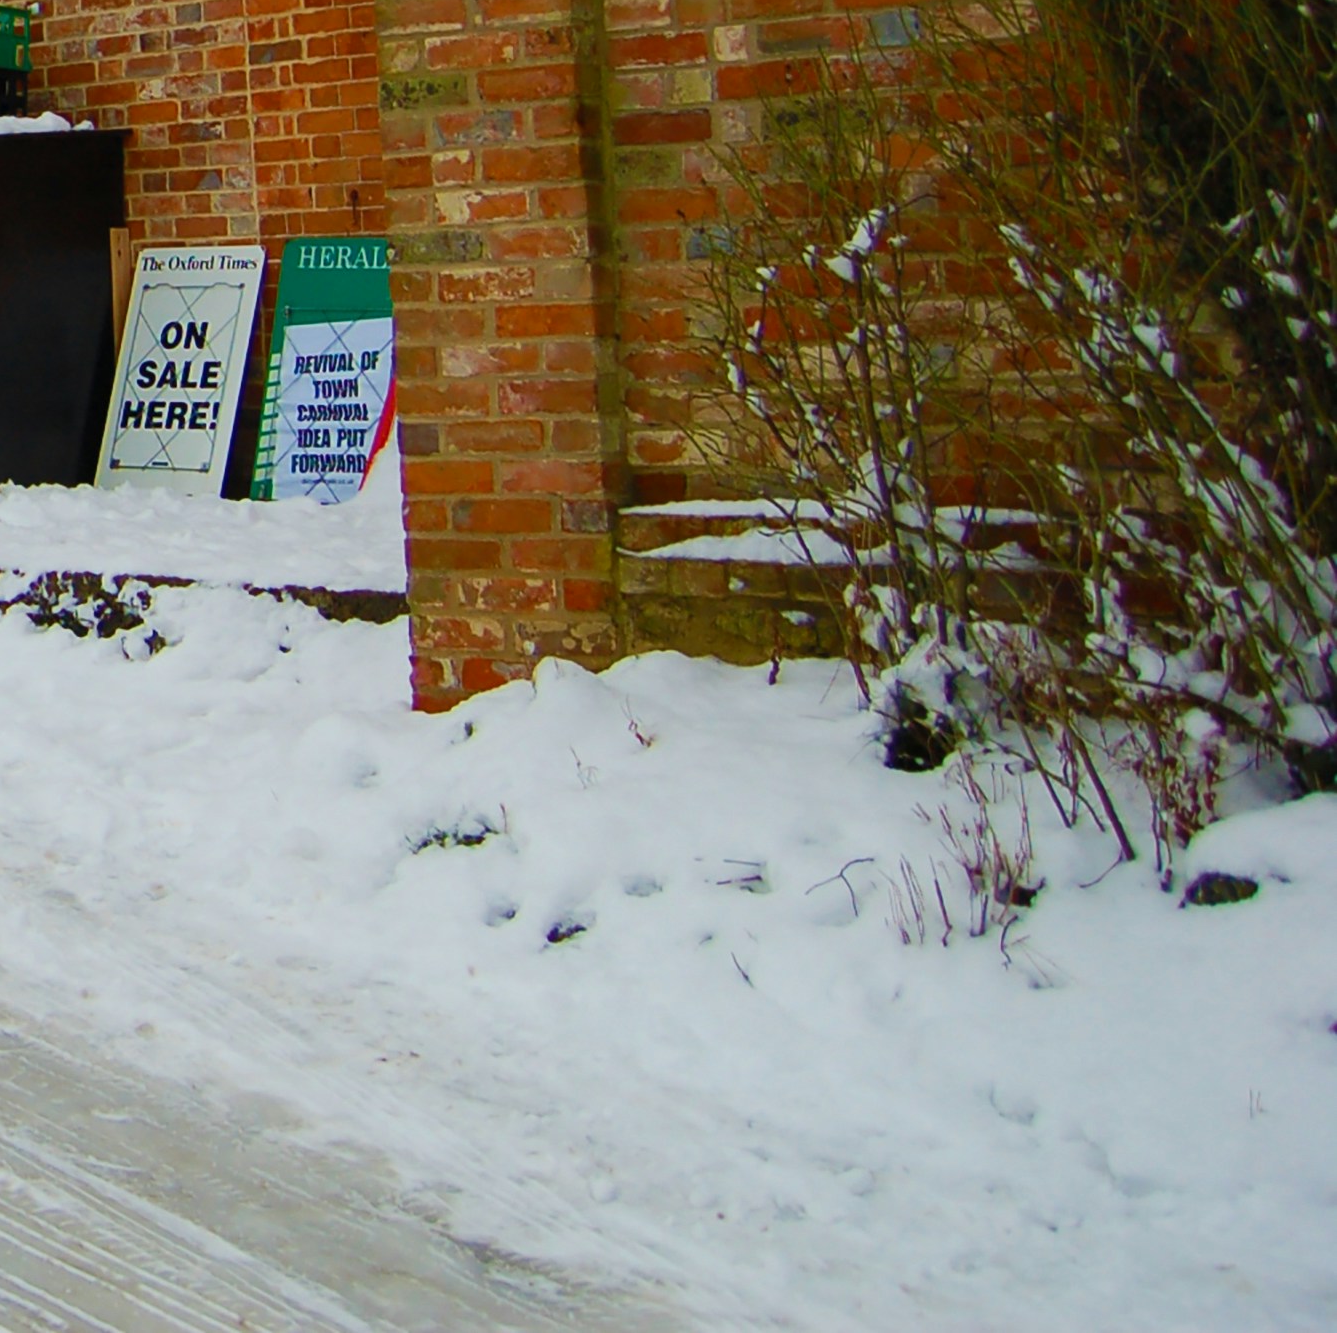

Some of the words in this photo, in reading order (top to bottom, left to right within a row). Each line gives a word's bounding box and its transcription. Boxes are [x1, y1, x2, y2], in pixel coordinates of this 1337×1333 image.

[141, 255, 166, 272] The
[168, 254, 215, 271] Oxford
[217, 254, 258, 270] Times
[297, 245, 391, 270] HERAL
[160, 321, 209, 350] ON
[136, 359, 222, 389] SALE
[293, 351, 355, 375] REVIVAL
[360, 350, 380, 372] OF
[312, 377, 359, 399] TOWN
[120, 400, 221, 430] HERE!
[296, 402, 370, 422] CARNIVAL
[297, 428, 332, 448] IDEA
[336, 428, 368, 448] PUT
[290, 453, 367, 474] FORWARD
